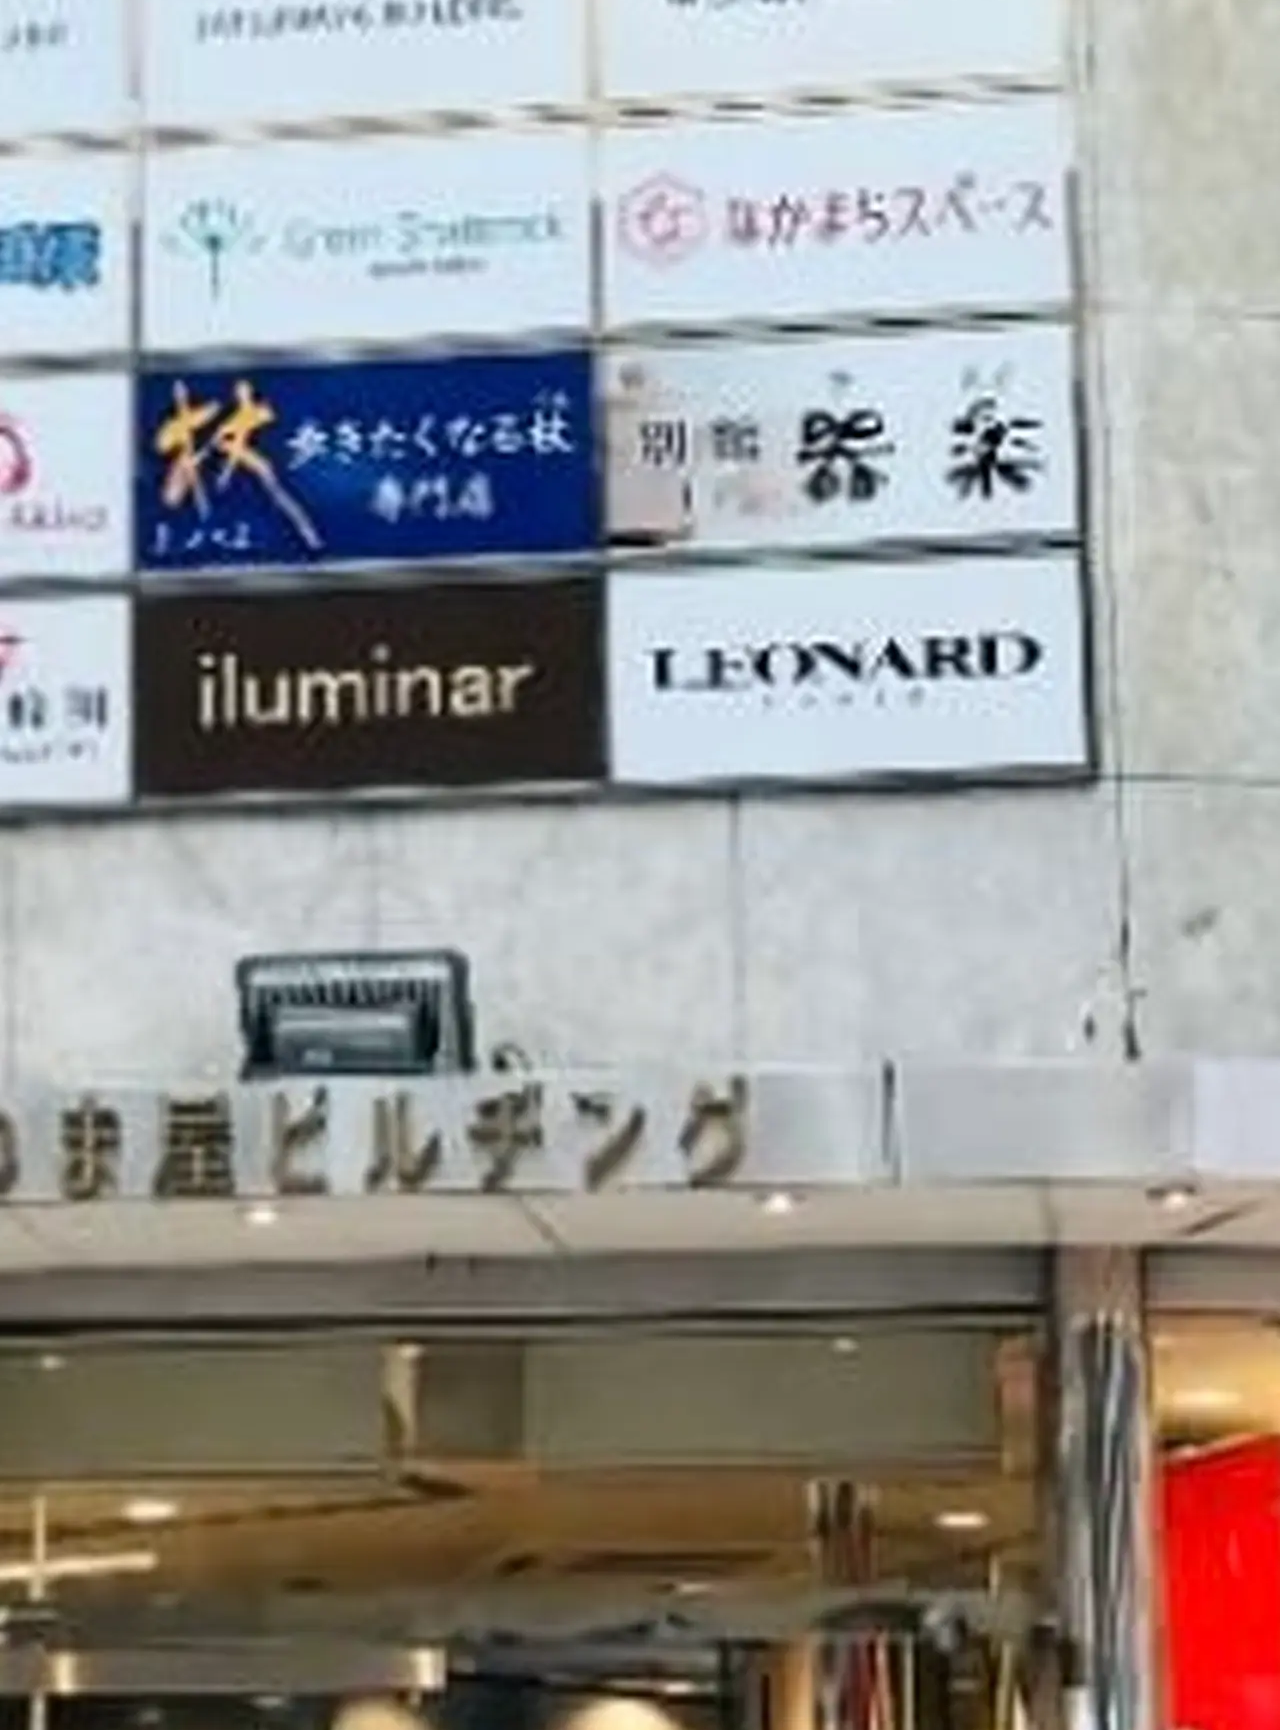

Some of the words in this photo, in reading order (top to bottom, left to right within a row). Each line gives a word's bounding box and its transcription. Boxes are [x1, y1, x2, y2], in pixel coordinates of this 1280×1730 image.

[726, 172, 1054, 248] なかまちスペース
[197, 643, 536, 731] iluminar
[650, 631, 1043, 693] LEONARD
